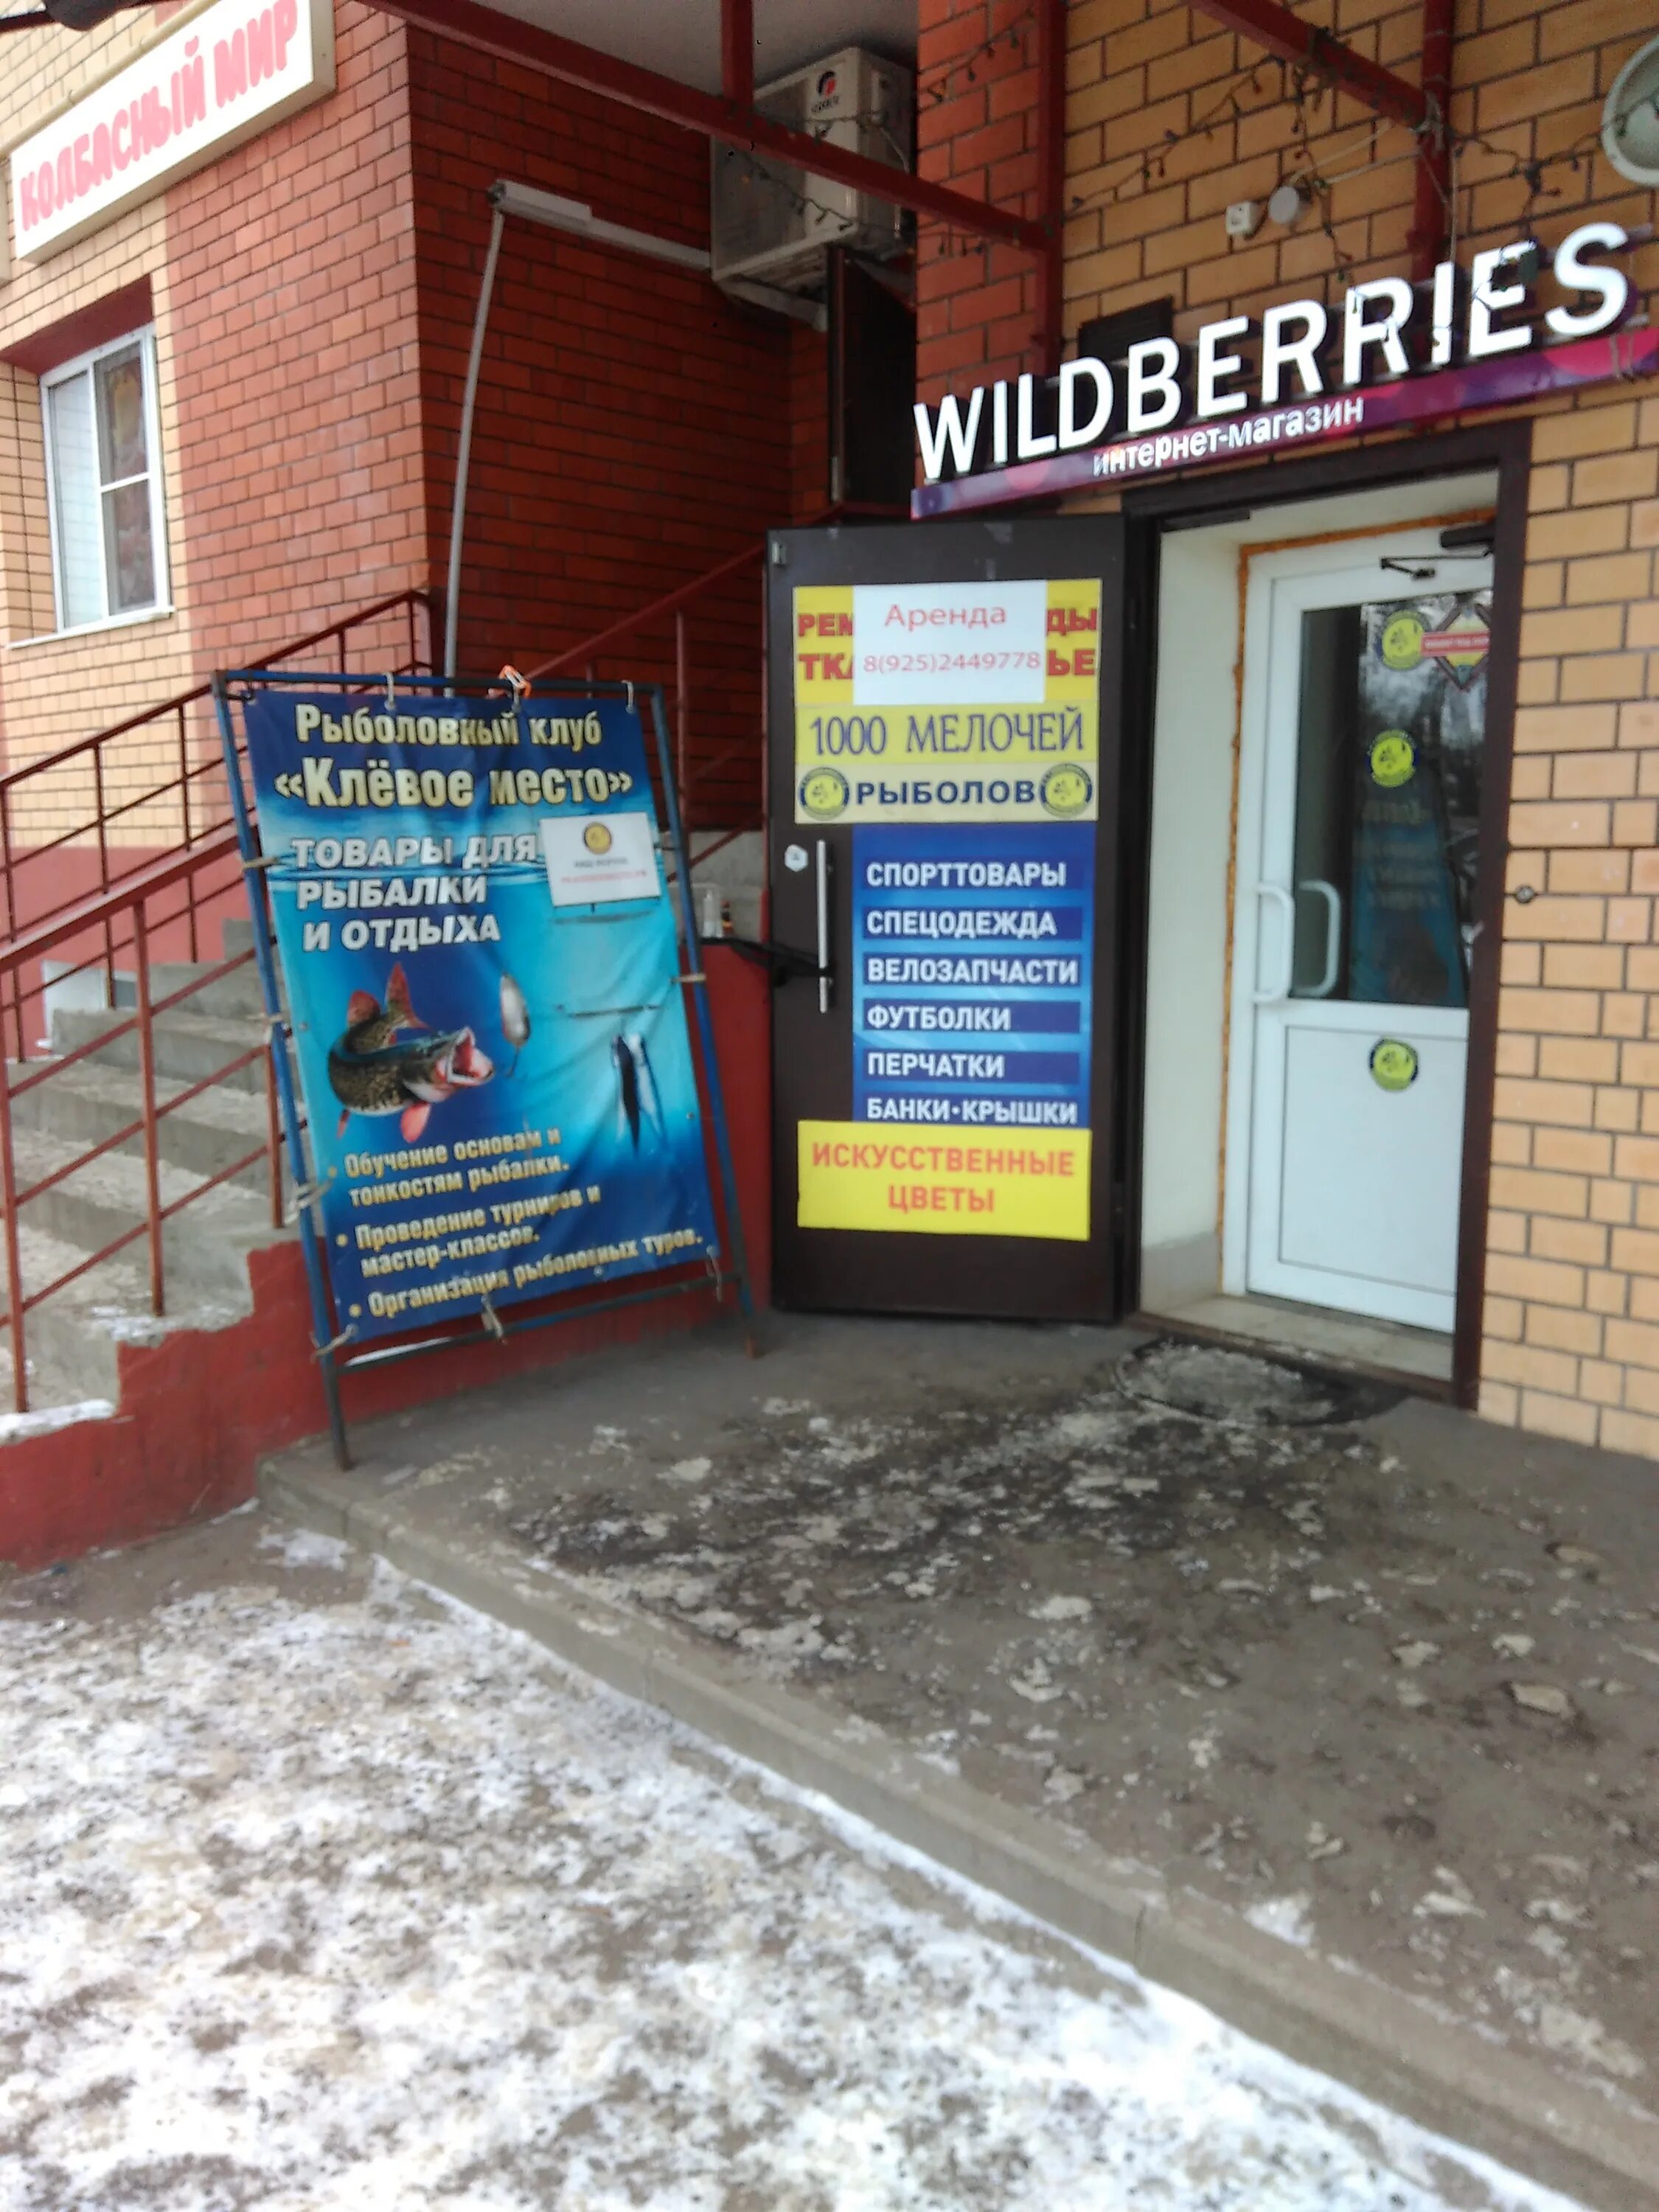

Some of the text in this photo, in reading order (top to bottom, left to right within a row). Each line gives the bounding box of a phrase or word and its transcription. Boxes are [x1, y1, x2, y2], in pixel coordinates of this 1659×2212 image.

[19, 0, 299, 232] КОЛБАСНЫЙ МИР
[913, 221, 1628, 480] WILDBERRIES
[1092, 396, 1364, 476] интернет-магазин
[885, 603, 1007, 633] Аренда
[863, 651, 1041, 674] 8(925)2449778
[295, 703, 603, 753] Рыболовный клуб
[810, 706, 1085, 756] 1000 МЕЛОЧЕЙ
[274, 756, 633, 808] «Клёвое место»
[856, 779, 1036, 806] РЫБОЛОВ
[291, 832, 537, 871] ТОВАРЫ ДЛЯ
[296, 874, 487, 911] РЫБАЛКИ
[866, 860, 1067, 888] СПОРТТОВАРЫ
[302, 913, 501, 954] И ОТДЫХА
[866, 909, 1057, 940] СПЕЦОДЕЖДА
[866, 958, 1079, 986] ВЕЛОЗАПЧАСТИ
[866, 1004, 1012, 1032] ФУТБОЛКИ
[866, 1051, 1006, 1079] ПЕРЧАТКИ
[344, 1127, 560, 1178] Обучение основам и
[811, 1141, 1075, 1177] ИСКУССТВЕННЫЕ
[348, 1155, 570, 1208] тонкостям рыбалки.
[888, 1184, 995, 1214] ЦВЕТЫ
[355, 1184, 601, 1252] Проведение турниров и
[360, 1225, 540, 1279] мастер-классов.
[368, 1228, 703, 1319] Организация рыболовных туров.
